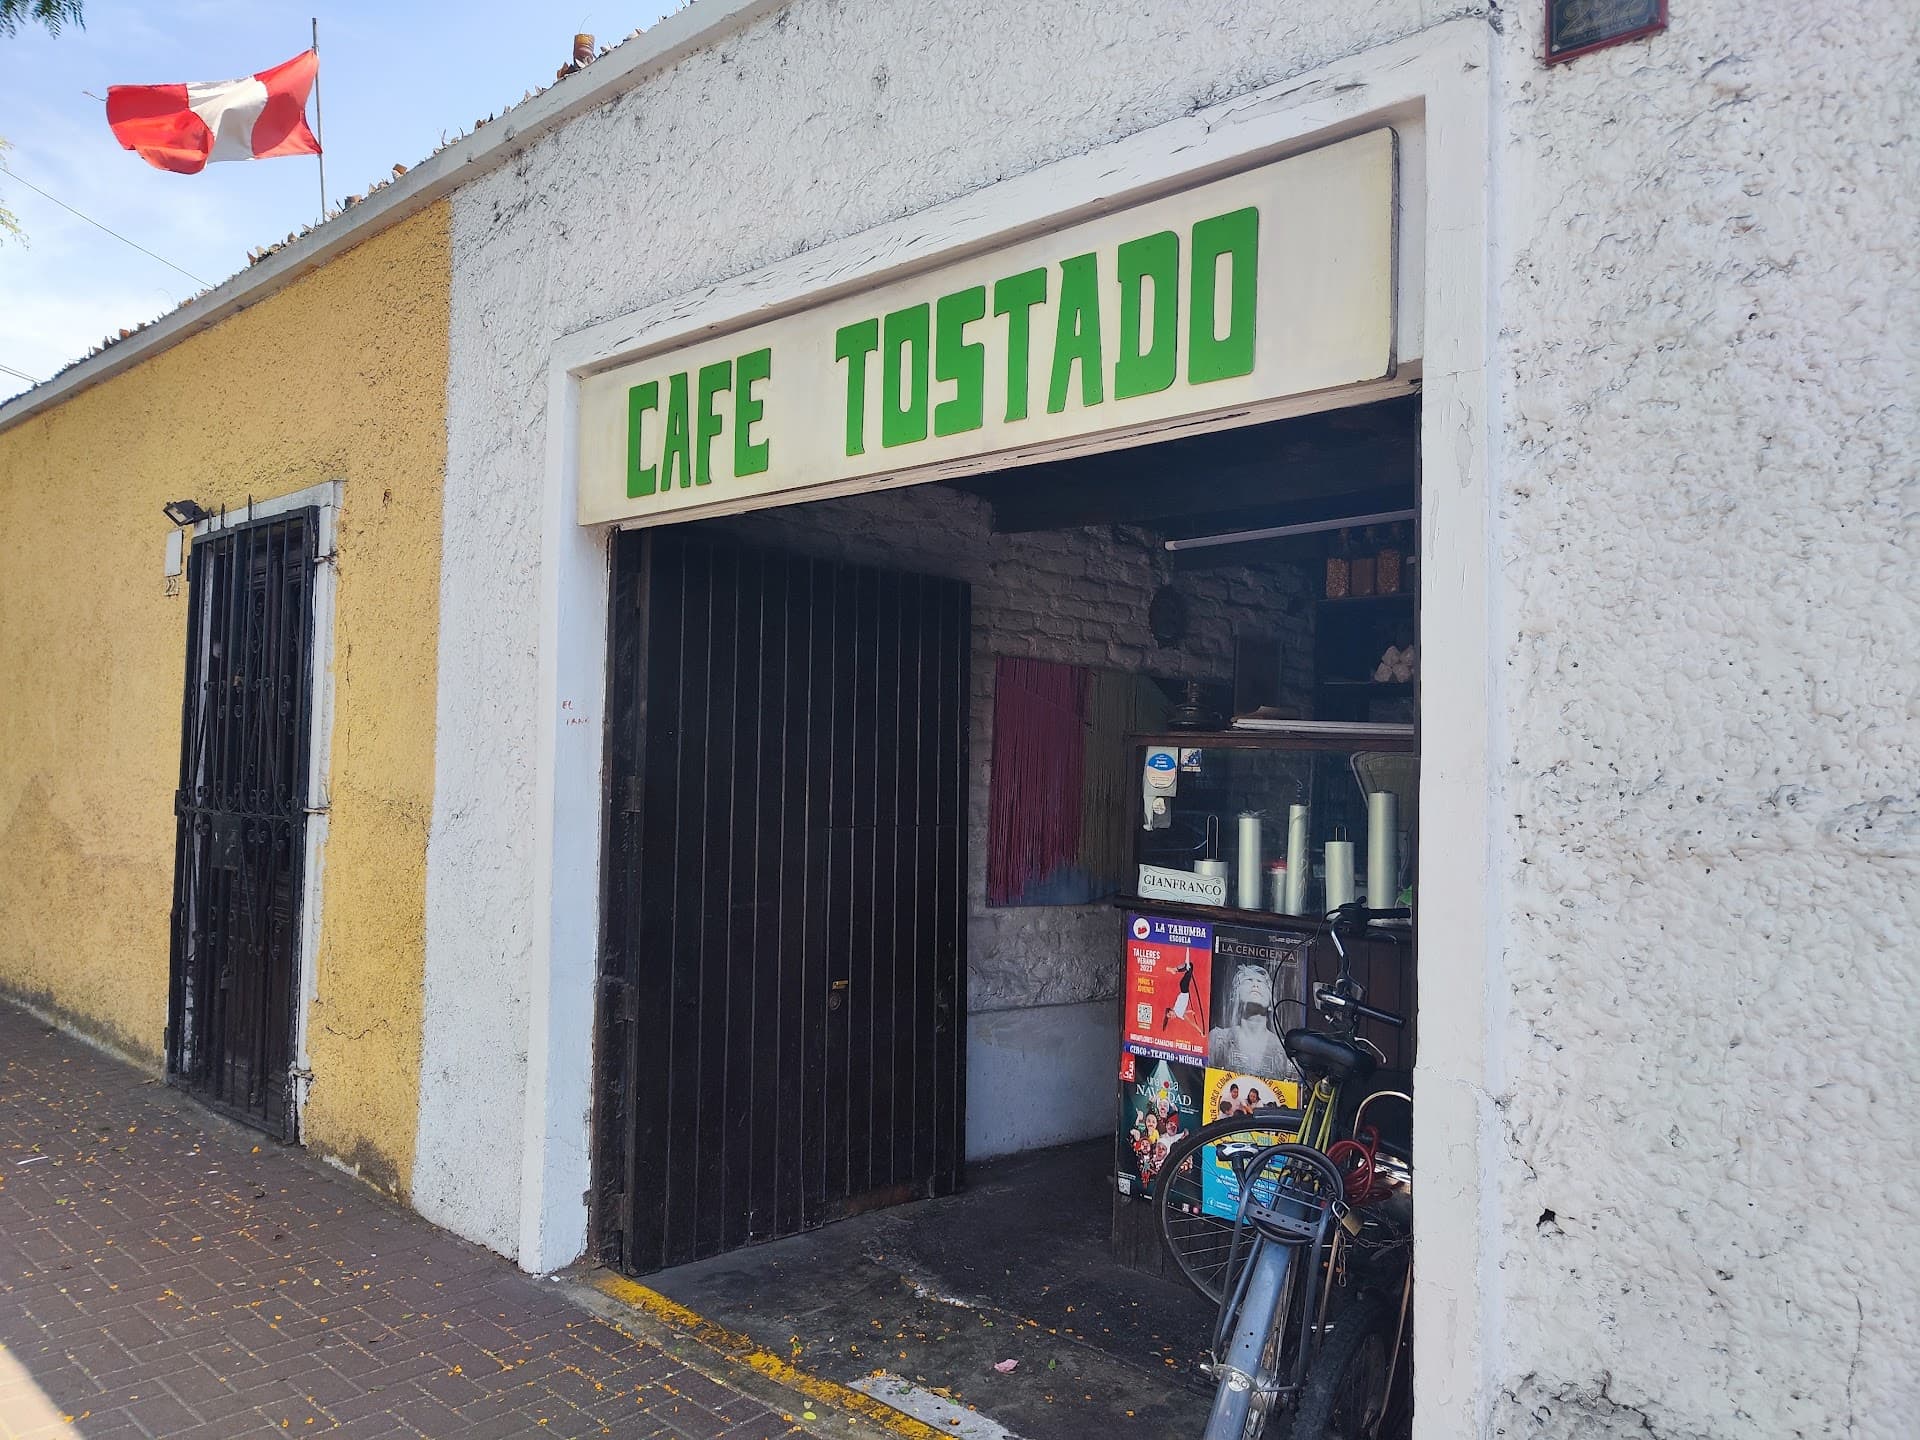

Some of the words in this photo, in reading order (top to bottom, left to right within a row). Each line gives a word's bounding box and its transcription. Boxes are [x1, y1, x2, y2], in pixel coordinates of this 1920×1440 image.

[626, 347, 772, 500] CAFE
[835, 205, 1261, 458] TOSTADO
[1143, 874, 1222, 896] GIANFRANCO
[1155, 922, 1166, 933] LA
[1168, 924, 1206, 938] TARUMBA
[1169, 934, 1191, 944] ESCUELA
[1133, 947, 1161, 960] TALLERES
[1221, 943, 1234, 953] LA
[1235, 945, 1295, 961] CENICIENTA
[1137, 957, 1156, 967] VERANO
[1140, 965, 1153, 973] 2023
[1130, 1045, 1147, 1056] CIRCO
[1150, 1049, 1174, 1061] TEATRO
[1179, 1053, 1203, 1067] MÚSICA
[1135, 1083, 1192, 1106] NAVDAD
